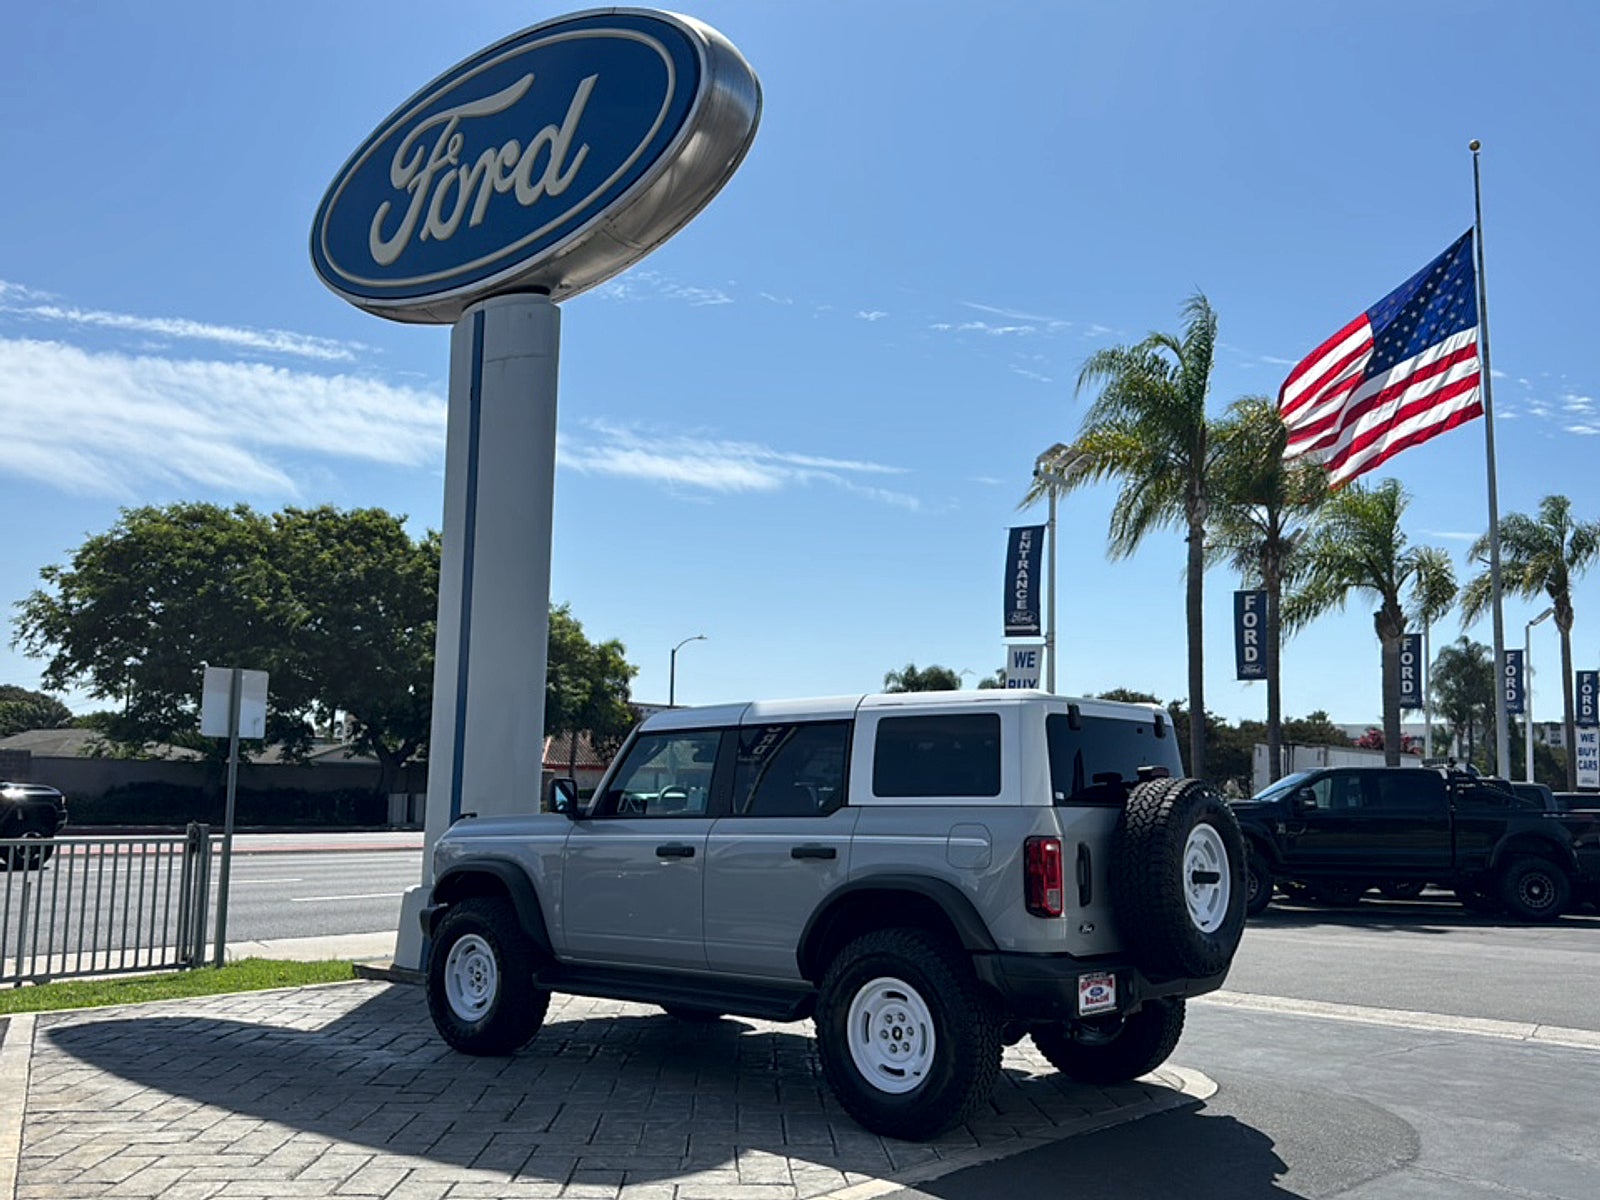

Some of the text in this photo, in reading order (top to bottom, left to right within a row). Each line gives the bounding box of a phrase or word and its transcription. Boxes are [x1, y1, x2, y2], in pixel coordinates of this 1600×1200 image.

[370, 73, 599, 266] Ford
[1016, 530, 1032, 610] ENTRANCE
[1243, 595, 1258, 662] FORD
[1014, 651, 1036, 668] WE
[1401, 638, 1414, 693] FORD
[1505, 653, 1516, 701] FORD
[1581, 673, 1592, 715] FORD
[1578, 747, 1596, 757] BUY
[1580, 733, 1595, 742] WE
[1578, 760, 1597, 771] CARS
